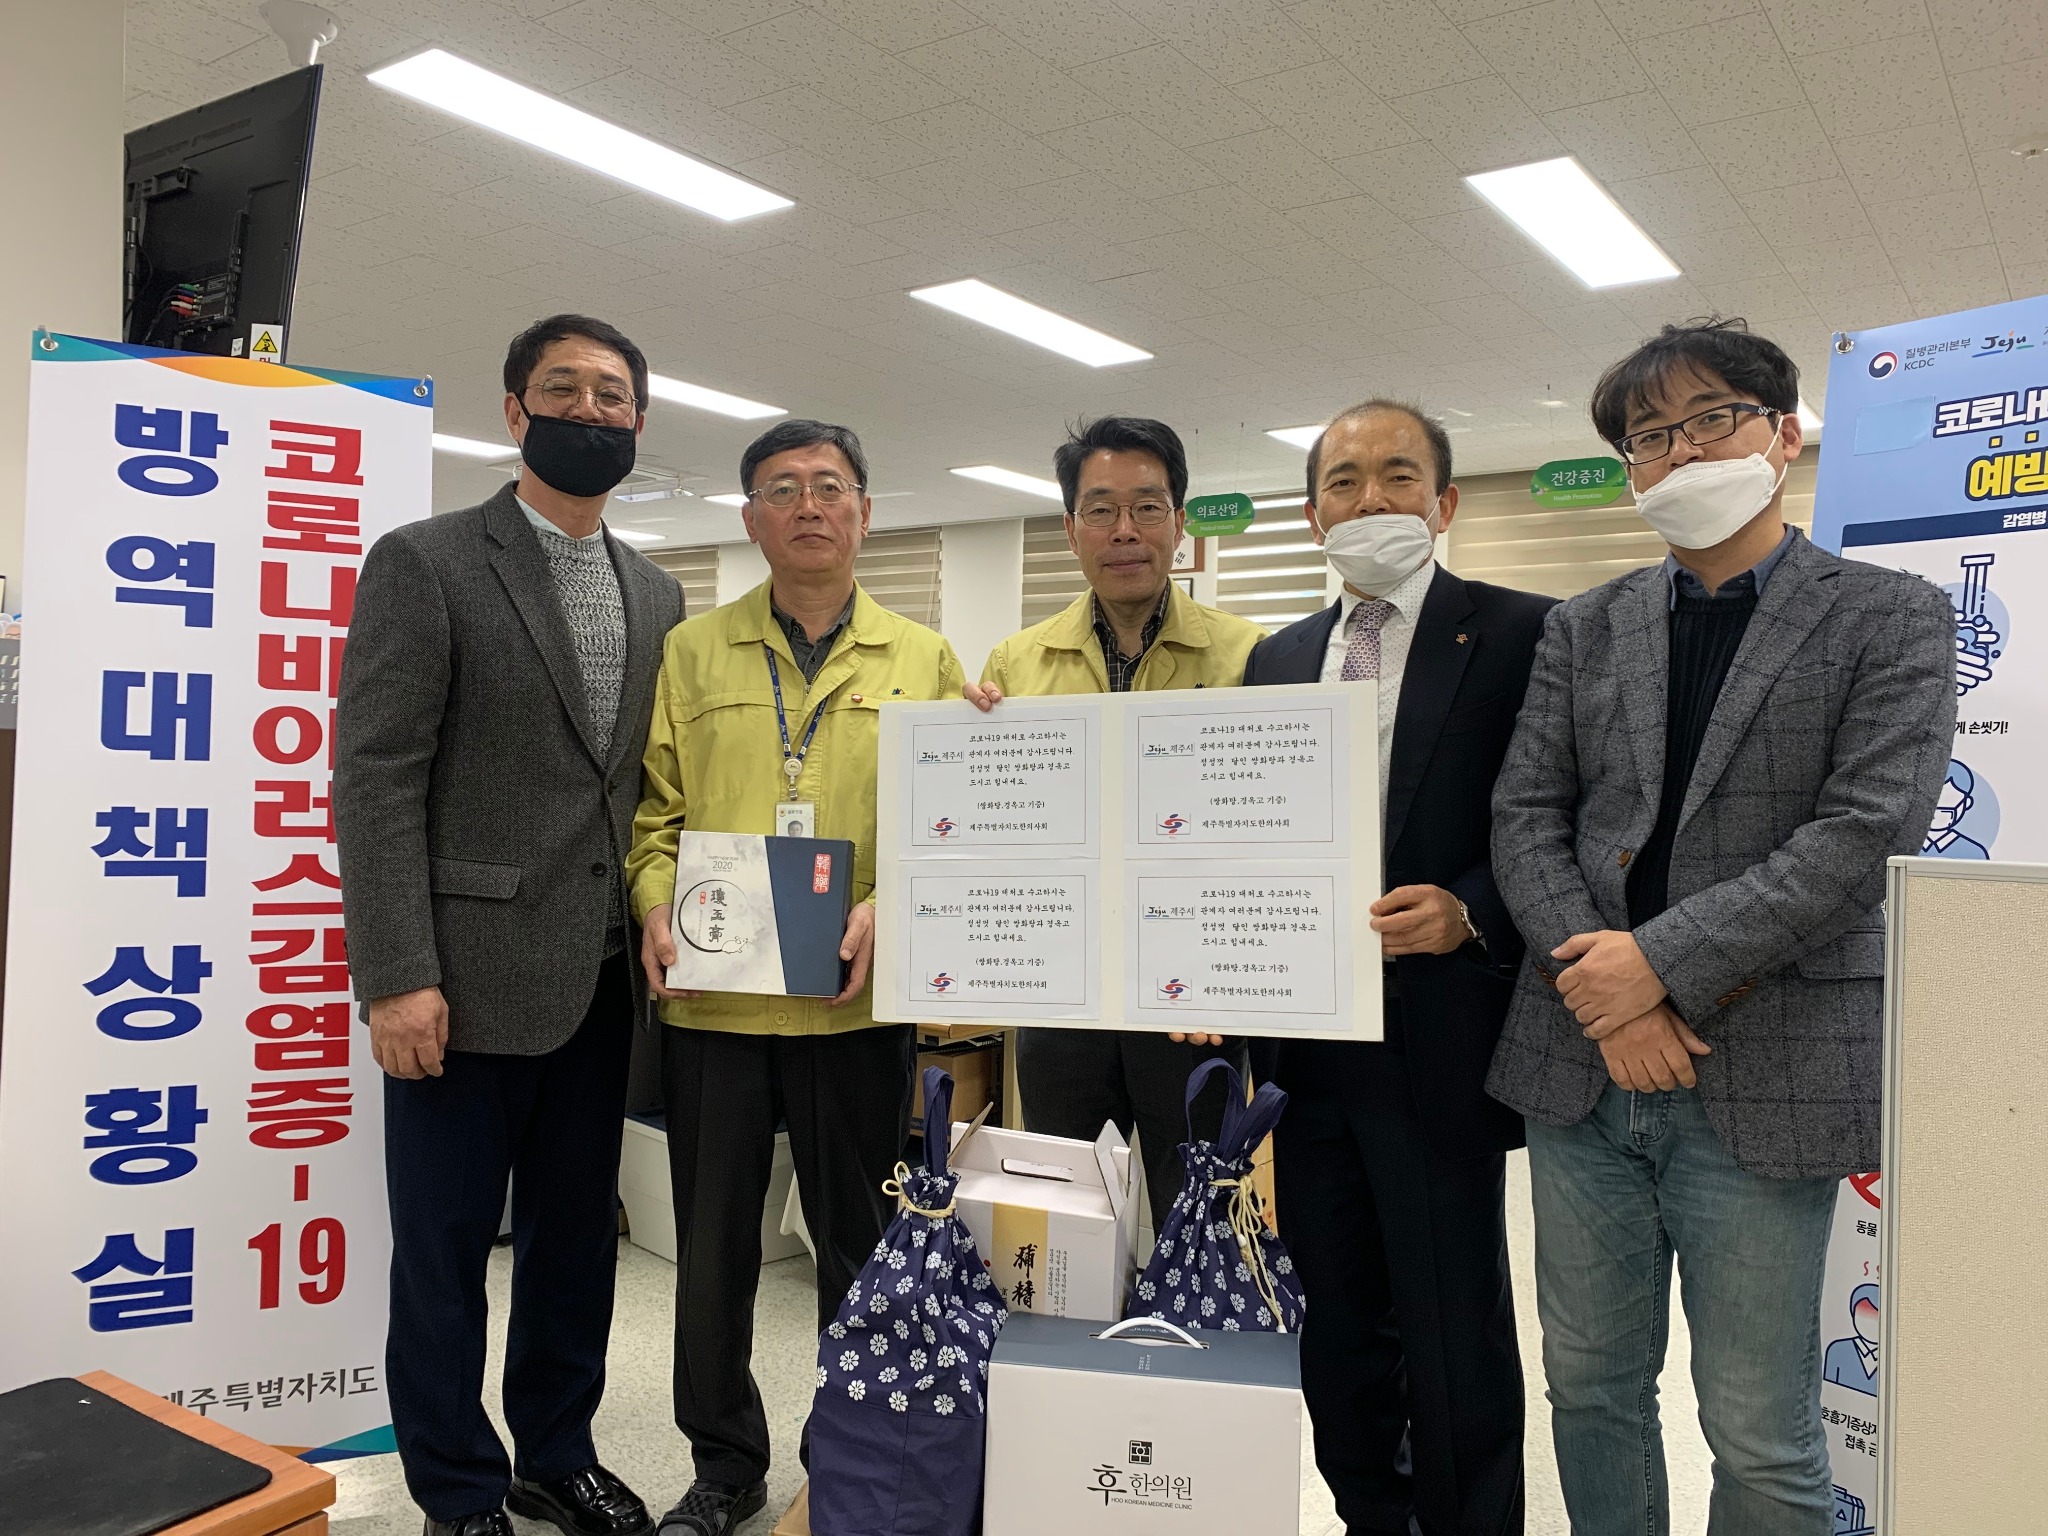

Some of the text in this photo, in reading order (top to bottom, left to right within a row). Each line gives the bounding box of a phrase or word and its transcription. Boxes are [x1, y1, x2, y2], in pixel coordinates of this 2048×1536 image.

[1981, 330, 2027, 352] Jeju
[1906, 338, 1971, 359] 질병관리본부
[1904, 358, 1936, 371] KCDC
[1934, 387, 2048, 437] 코로나
[1551, 468, 1605, 487] 건강증진
[1197, 502, 1238, 518] 의료산업
[2003, 511, 2047, 528] 감염병
[1199, 725, 1235, 735] 코로나19
[1968, 720, 2009, 735] 손씻기!
[968, 733, 1001, 743] 코로나19
[1168, 744, 1194, 755] 제주시
[940, 751, 964, 761] 제주시
[1200, 771, 1226, 782] 드시고
[968, 778, 992, 787] 드시고
[712, 860, 733, 870] 2020
[967, 887, 1000, 897] 코로나19
[1200, 888, 1236, 899] 코로나19
[940, 905, 961, 914] 제주시
[1171, 907, 1195, 916] 제주시
[967, 933, 991, 942] 드시고
[1201, 936, 1228, 947] 드시고
[1856, 1219, 1877, 1238] 동물
[1845, 1433, 1866, 1453] 접촉
[1087, 1464, 1192, 1506] 후 한의원
[1124, 1498, 1147, 1506] KOREAN
[1148, 1500, 1174, 1508] MEDICINE
